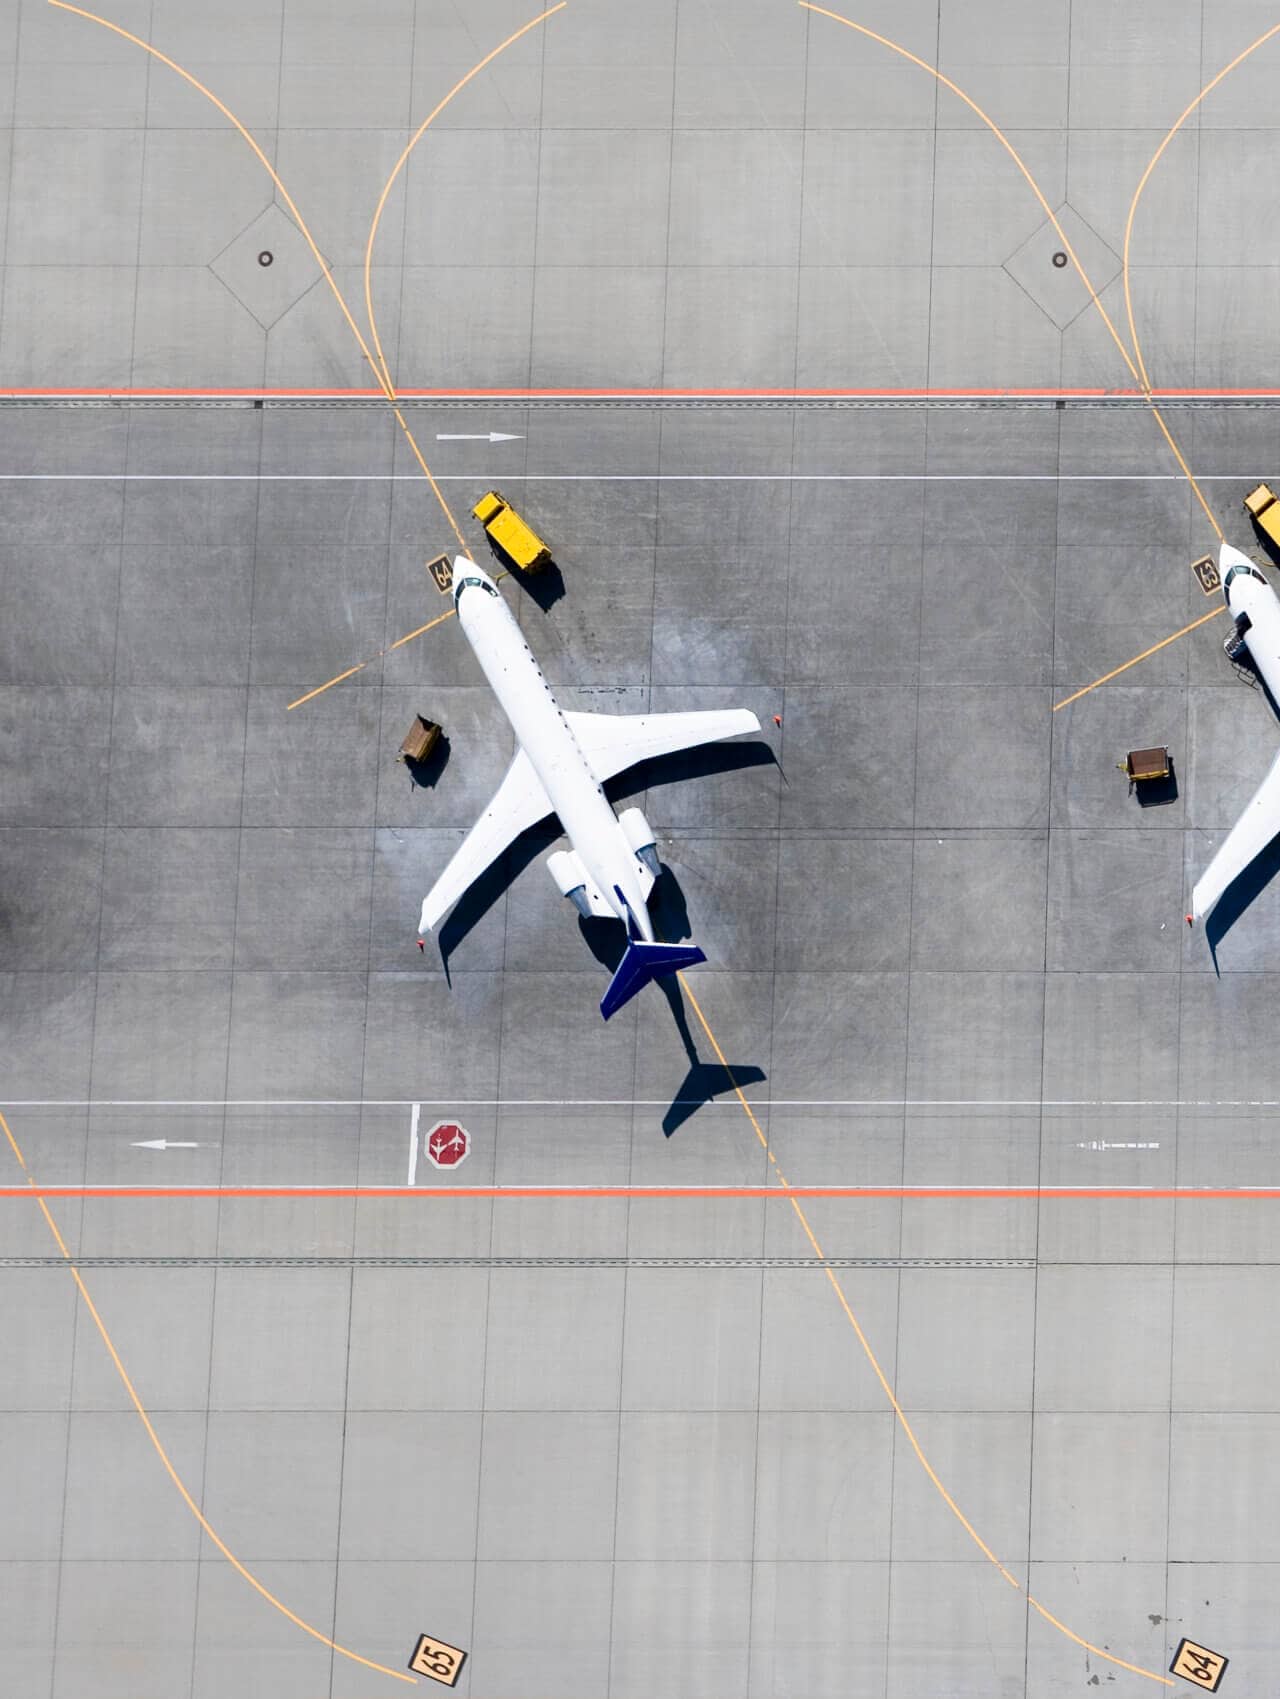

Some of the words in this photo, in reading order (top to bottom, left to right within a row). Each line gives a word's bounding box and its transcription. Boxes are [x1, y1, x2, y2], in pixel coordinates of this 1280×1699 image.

[434, 560, 452, 587] 64
[1200, 562, 1218, 588] 63
[421, 1646, 455, 1676] 65
[1182, 1649, 1218, 1681] 64
